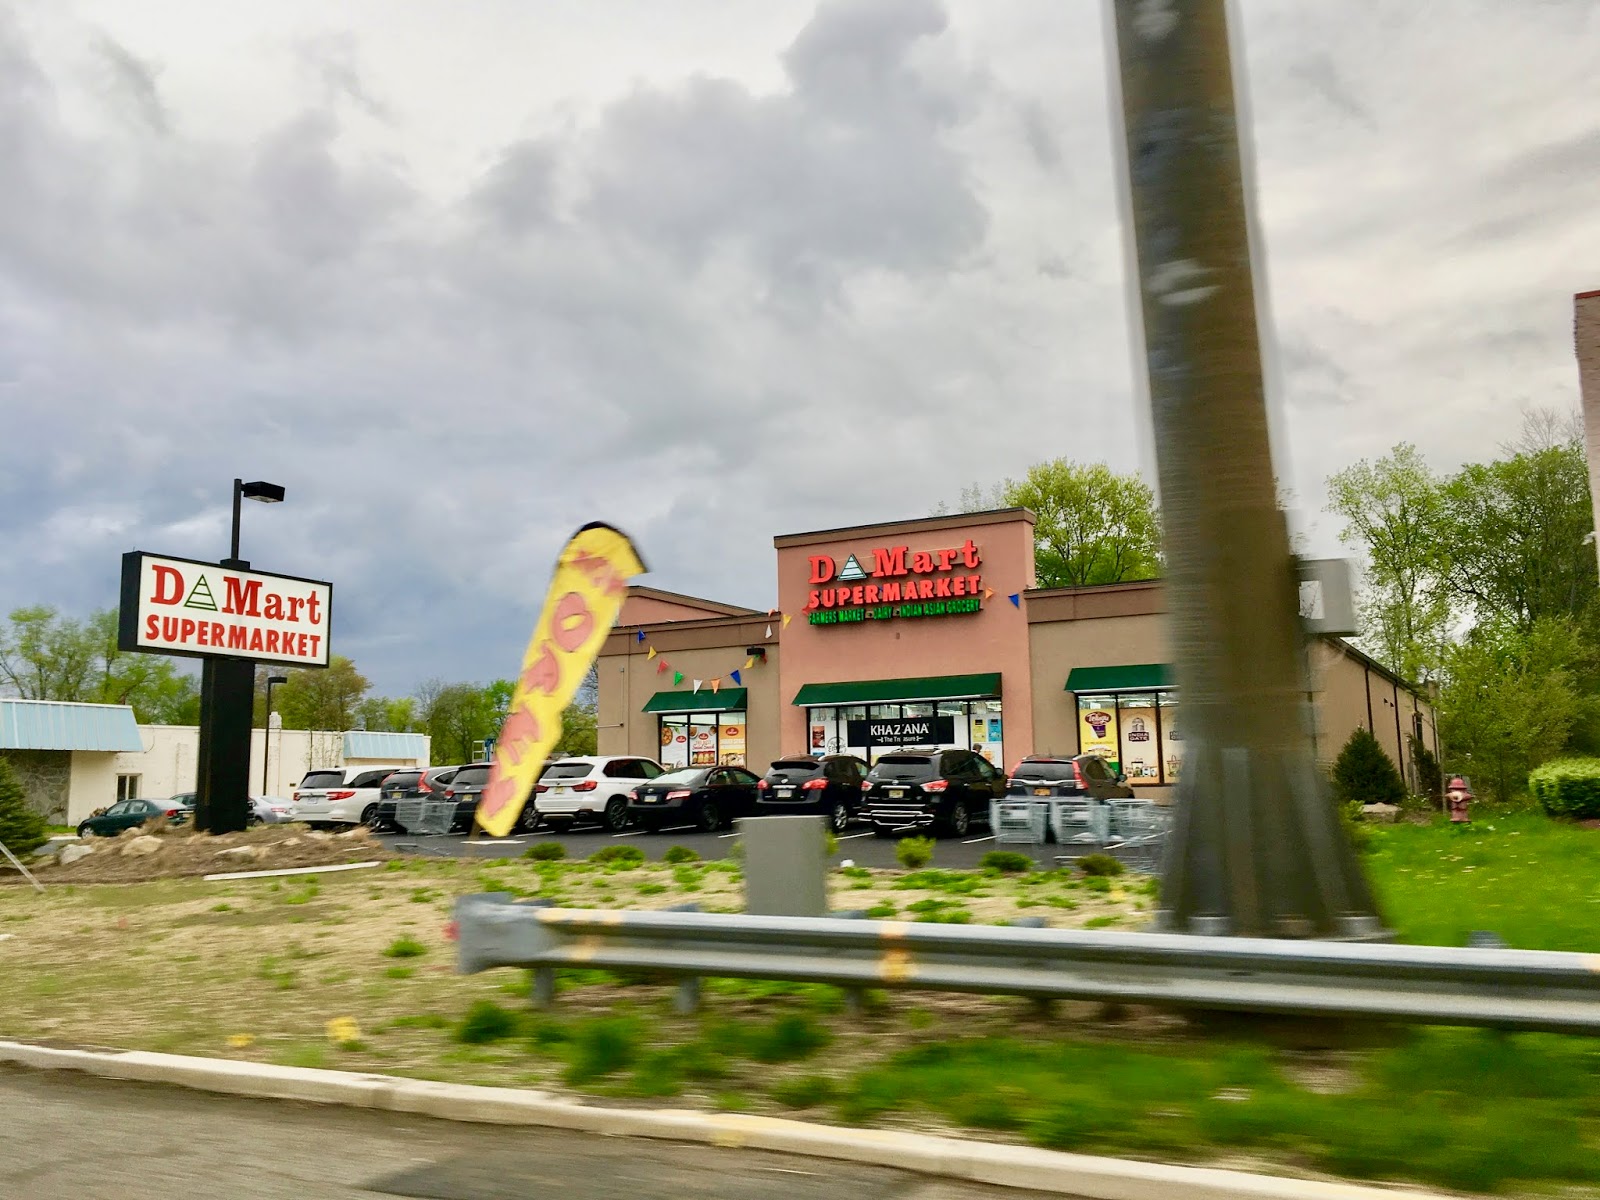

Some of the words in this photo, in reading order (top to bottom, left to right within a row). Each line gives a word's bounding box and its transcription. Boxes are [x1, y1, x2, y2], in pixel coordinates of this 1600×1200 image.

[808, 555, 835, 584] D
[872, 539, 980, 578] Mart
[150, 564, 185, 606] D
[222, 576, 321, 625] Mart
[809, 575, 981, 609] SUPERMARKET
[808, 610, 837, 625] FARMERS
[838, 608, 866, 623] MARKET
[873, 606, 893, 620] DAIRY
[900, 604, 923, 618] INDIAN
[924, 602, 946, 616] ASIAN
[947, 599, 981, 614] GROCERY
[145, 614, 321, 658] SUPERMARKET
[870, 723, 929, 736] KHAZANA
